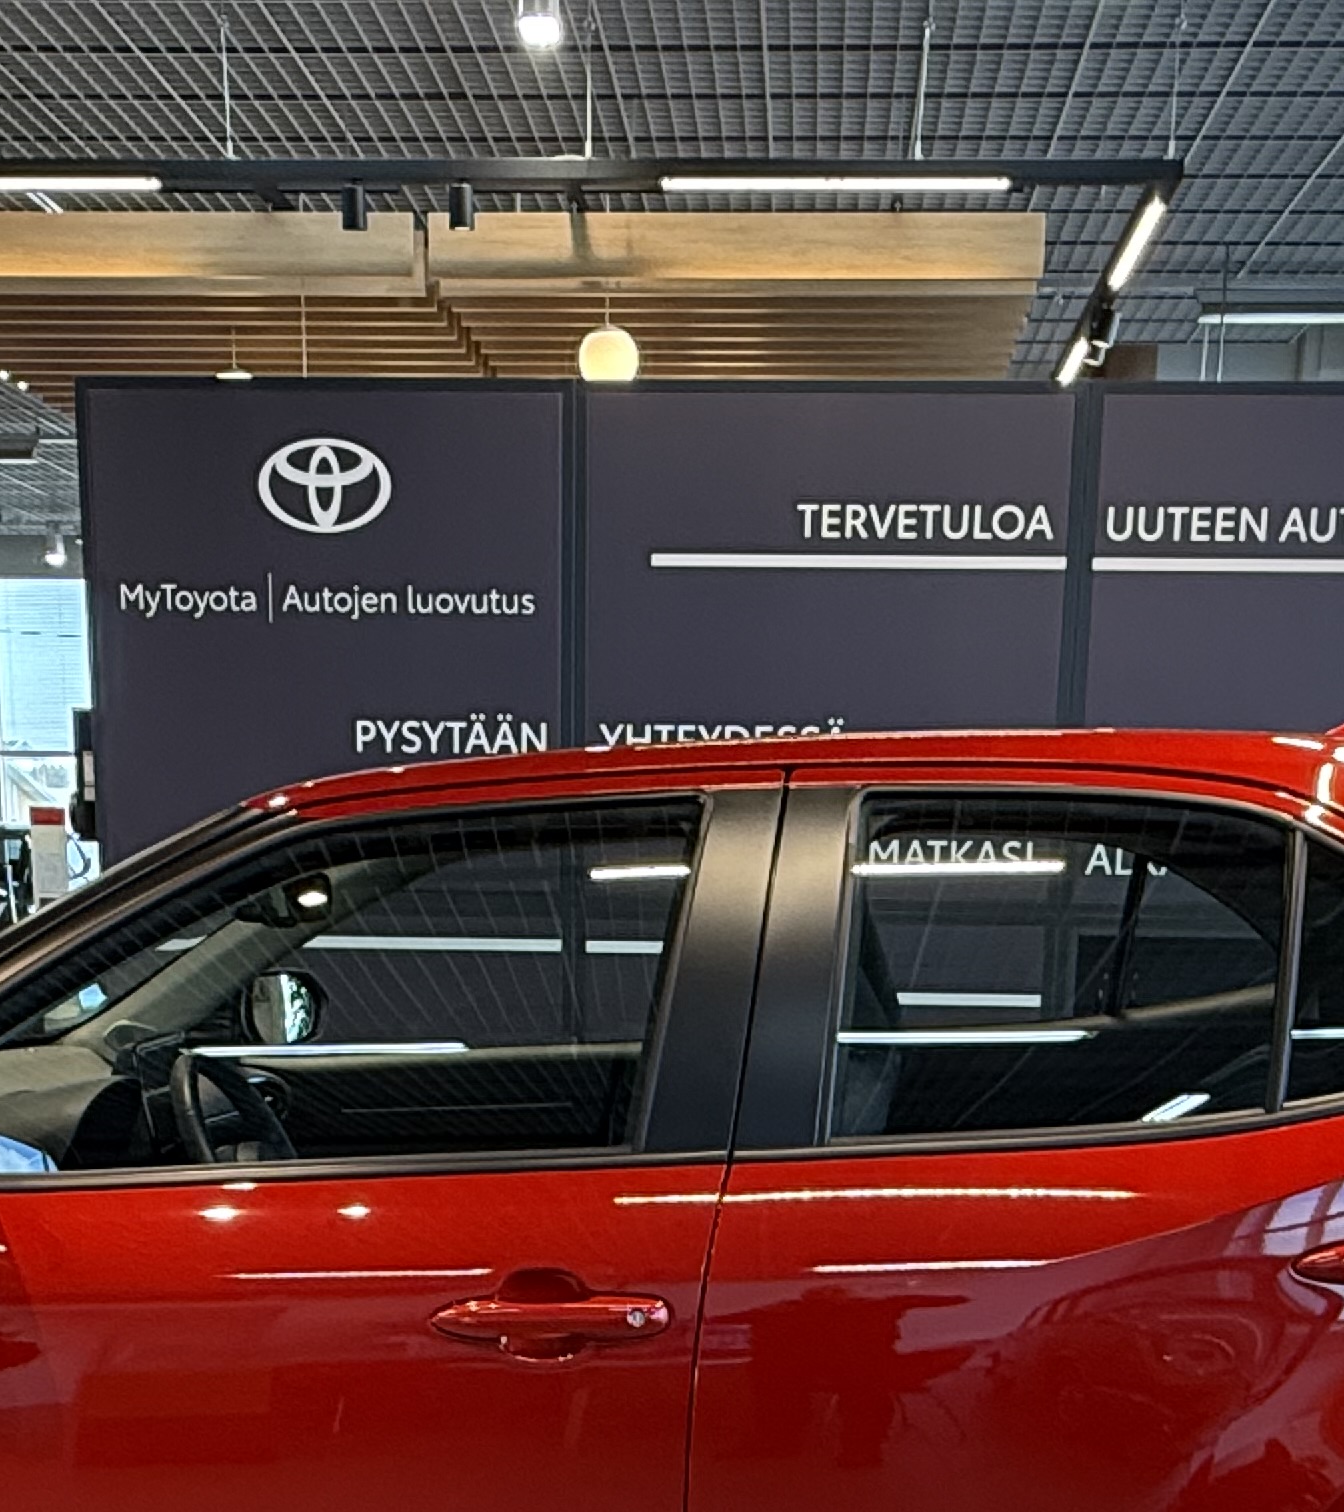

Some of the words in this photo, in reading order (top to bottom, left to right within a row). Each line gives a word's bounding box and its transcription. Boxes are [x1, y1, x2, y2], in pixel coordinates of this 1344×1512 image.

[796, 503, 1054, 541] TERVETULOA
[1105, 505, 1269, 543] UUTEEN
[119, 583, 257, 619] MyToyota
[281, 584, 398, 620] Autojen
[407, 584, 536, 615] luovutus
[355, 712, 549, 755] PYSYTÄÄN
[867, 838, 1035, 866] MATKASI
